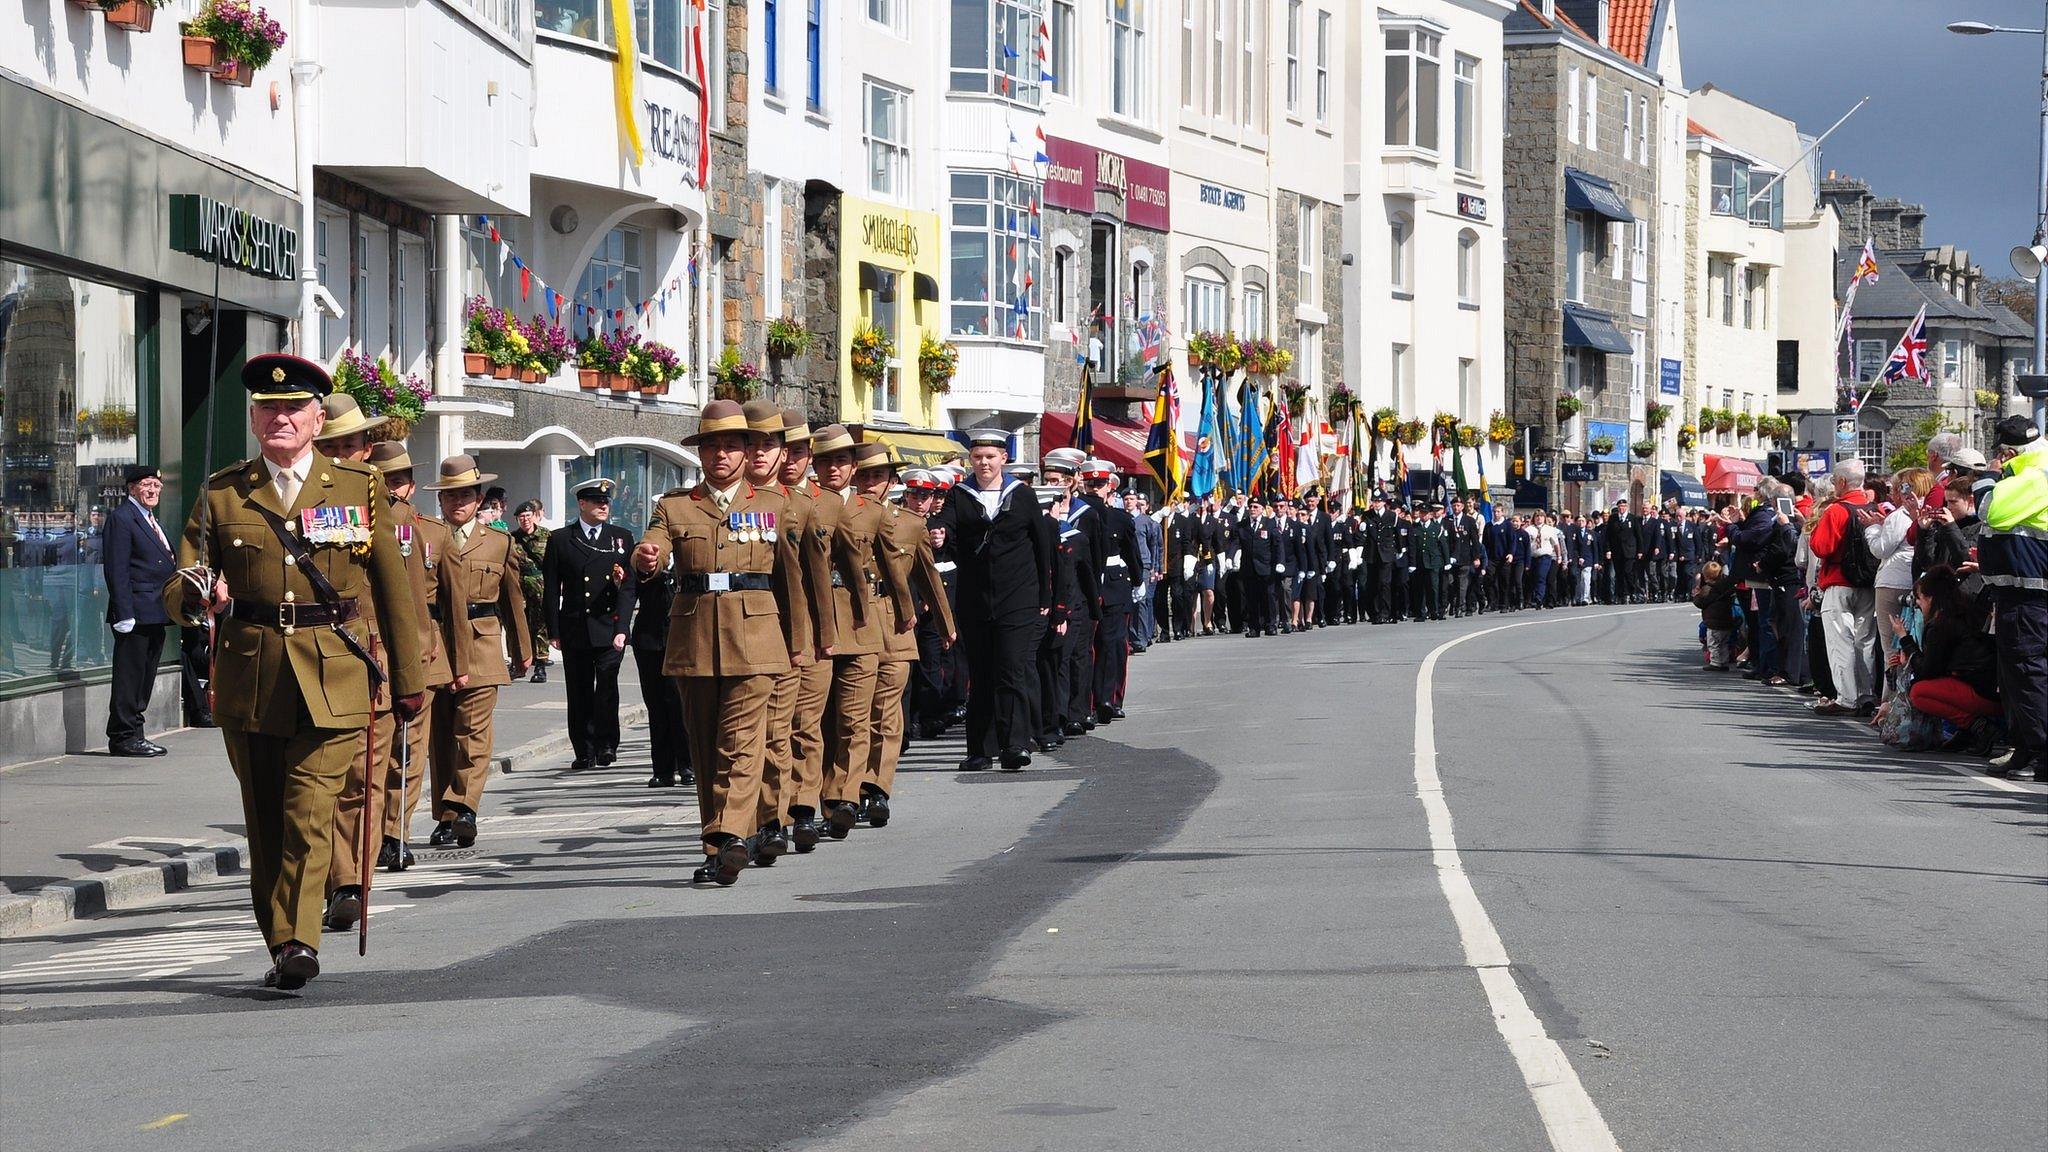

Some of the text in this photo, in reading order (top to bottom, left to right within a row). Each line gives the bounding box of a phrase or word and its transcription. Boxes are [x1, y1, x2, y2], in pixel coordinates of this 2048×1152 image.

[1200, 183, 1245, 211] ESTATE AGENTS
[862, 214, 919, 264] SMUGGLERS
